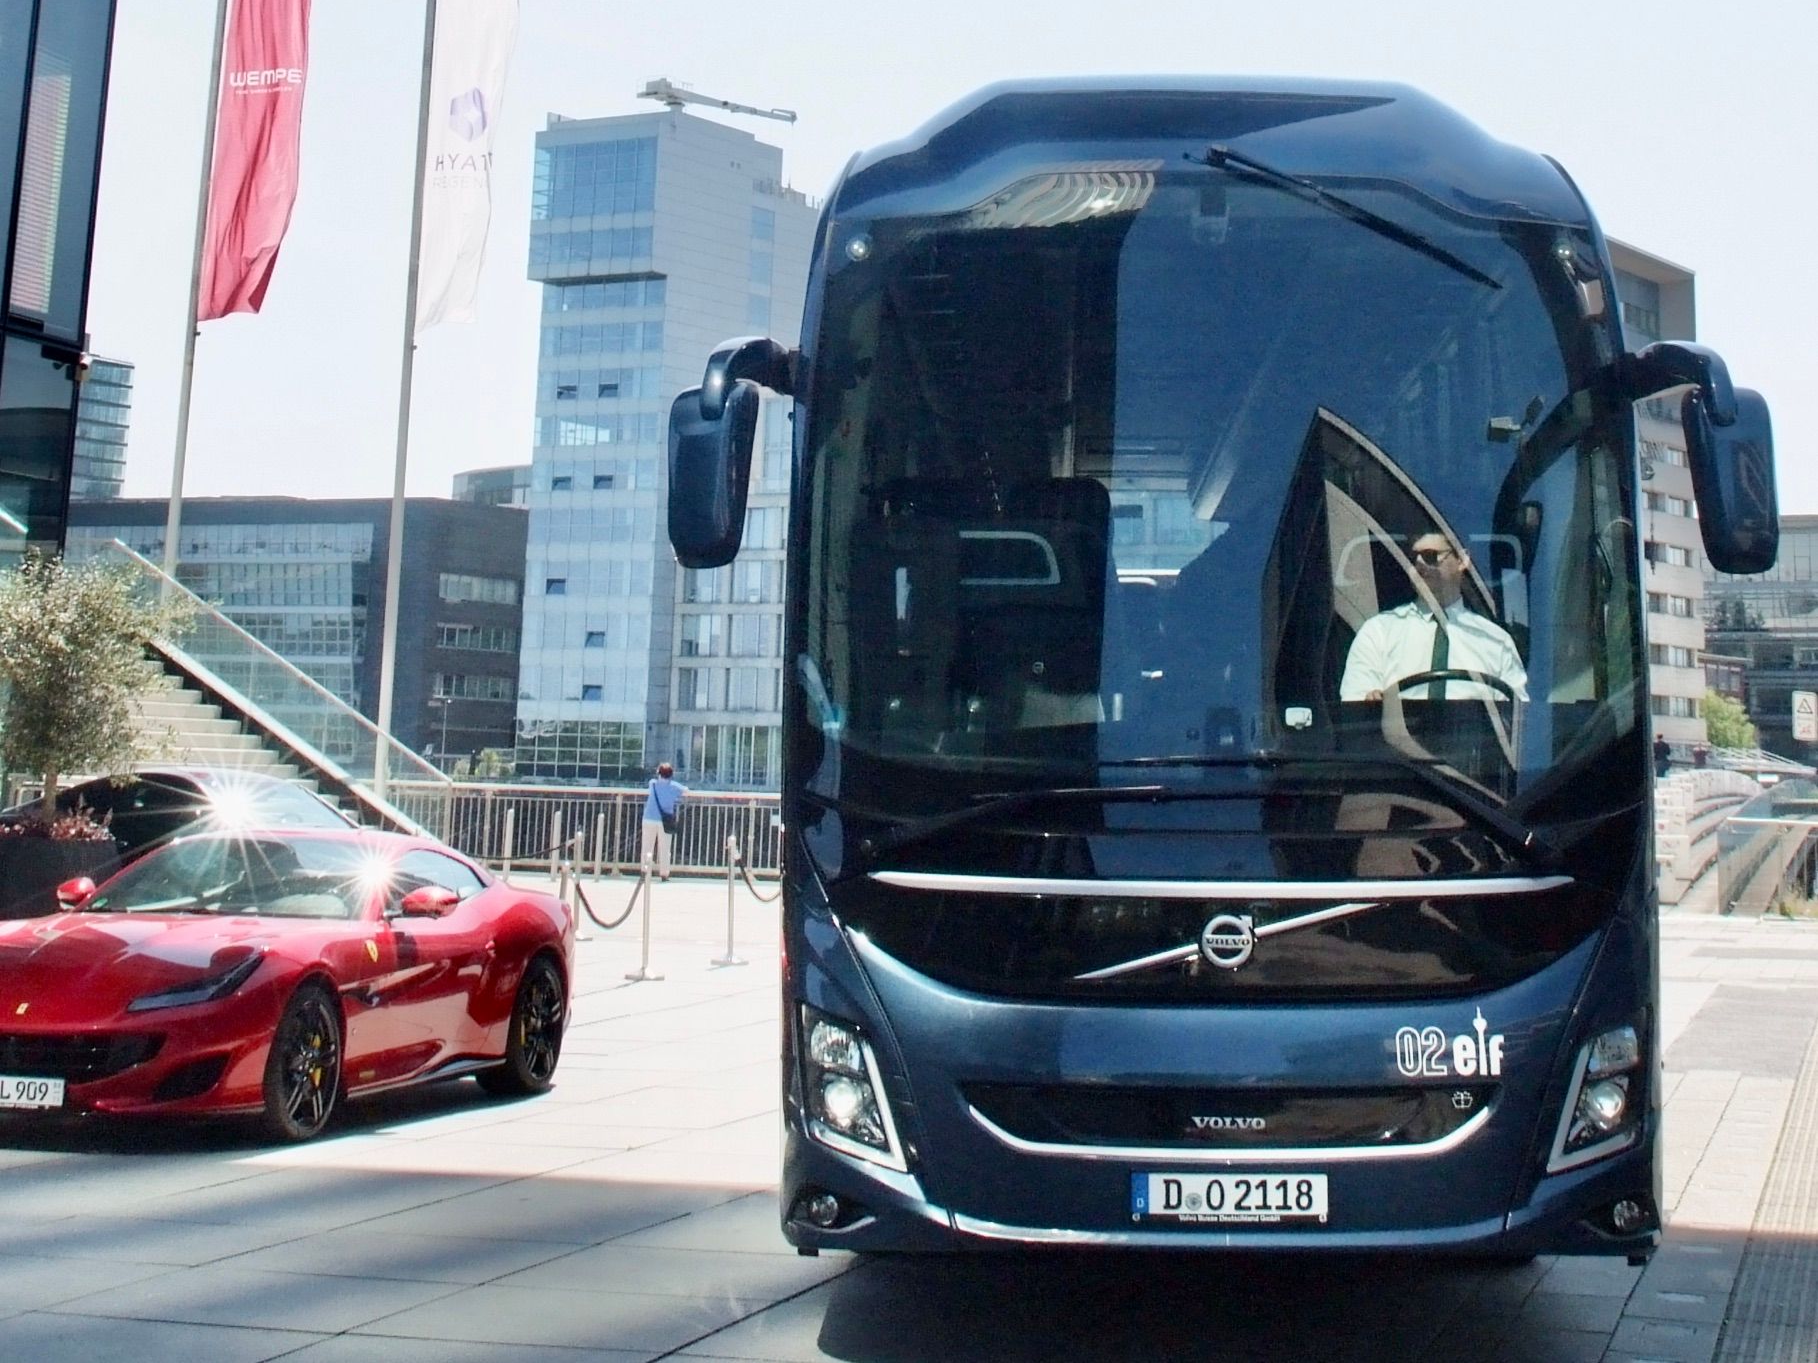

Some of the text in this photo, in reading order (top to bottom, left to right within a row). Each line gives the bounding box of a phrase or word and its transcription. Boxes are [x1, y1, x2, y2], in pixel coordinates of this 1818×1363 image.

[229, 67, 303, 87] WEMPE
[1205, 937, 1250, 947] VOLVO
[16, 1081, 49, 1101] 909
[1191, 1116, 1266, 1130] VOLVO
